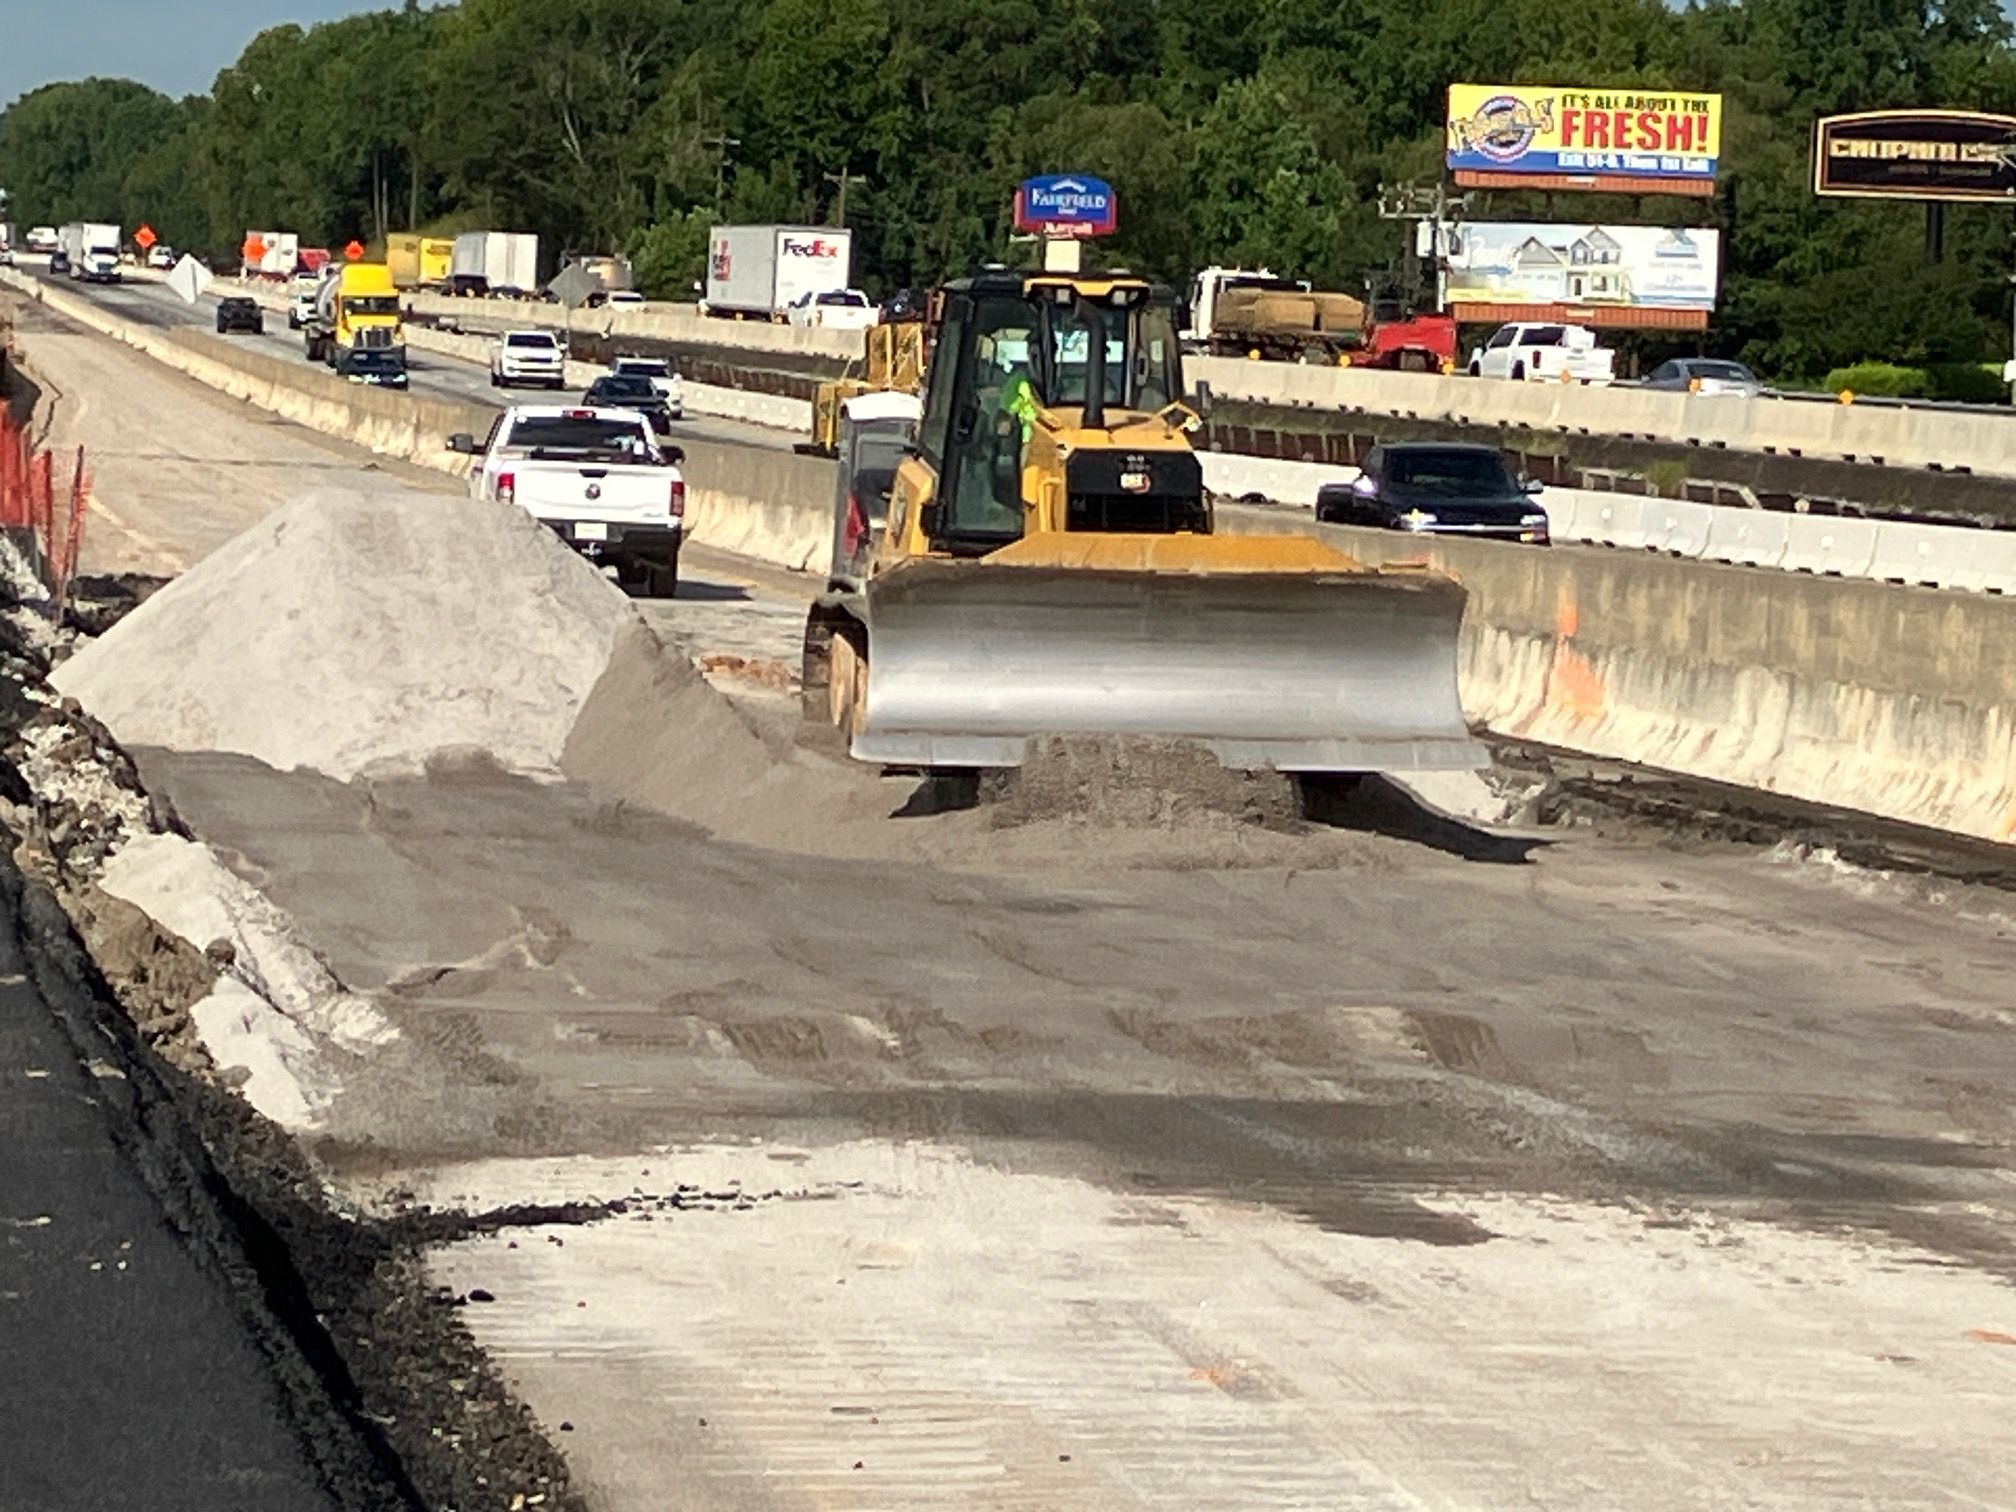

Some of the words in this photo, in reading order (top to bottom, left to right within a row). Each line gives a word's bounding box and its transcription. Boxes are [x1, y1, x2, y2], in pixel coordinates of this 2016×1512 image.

[1595, 95, 1620, 110] ALL
[1624, 96, 1676, 112] ABOUT
[1561, 109, 1709, 153] FRESH!
[1032, 188, 1106, 209] FAIRFIELD
[783, 238, 838, 258] FedEx
